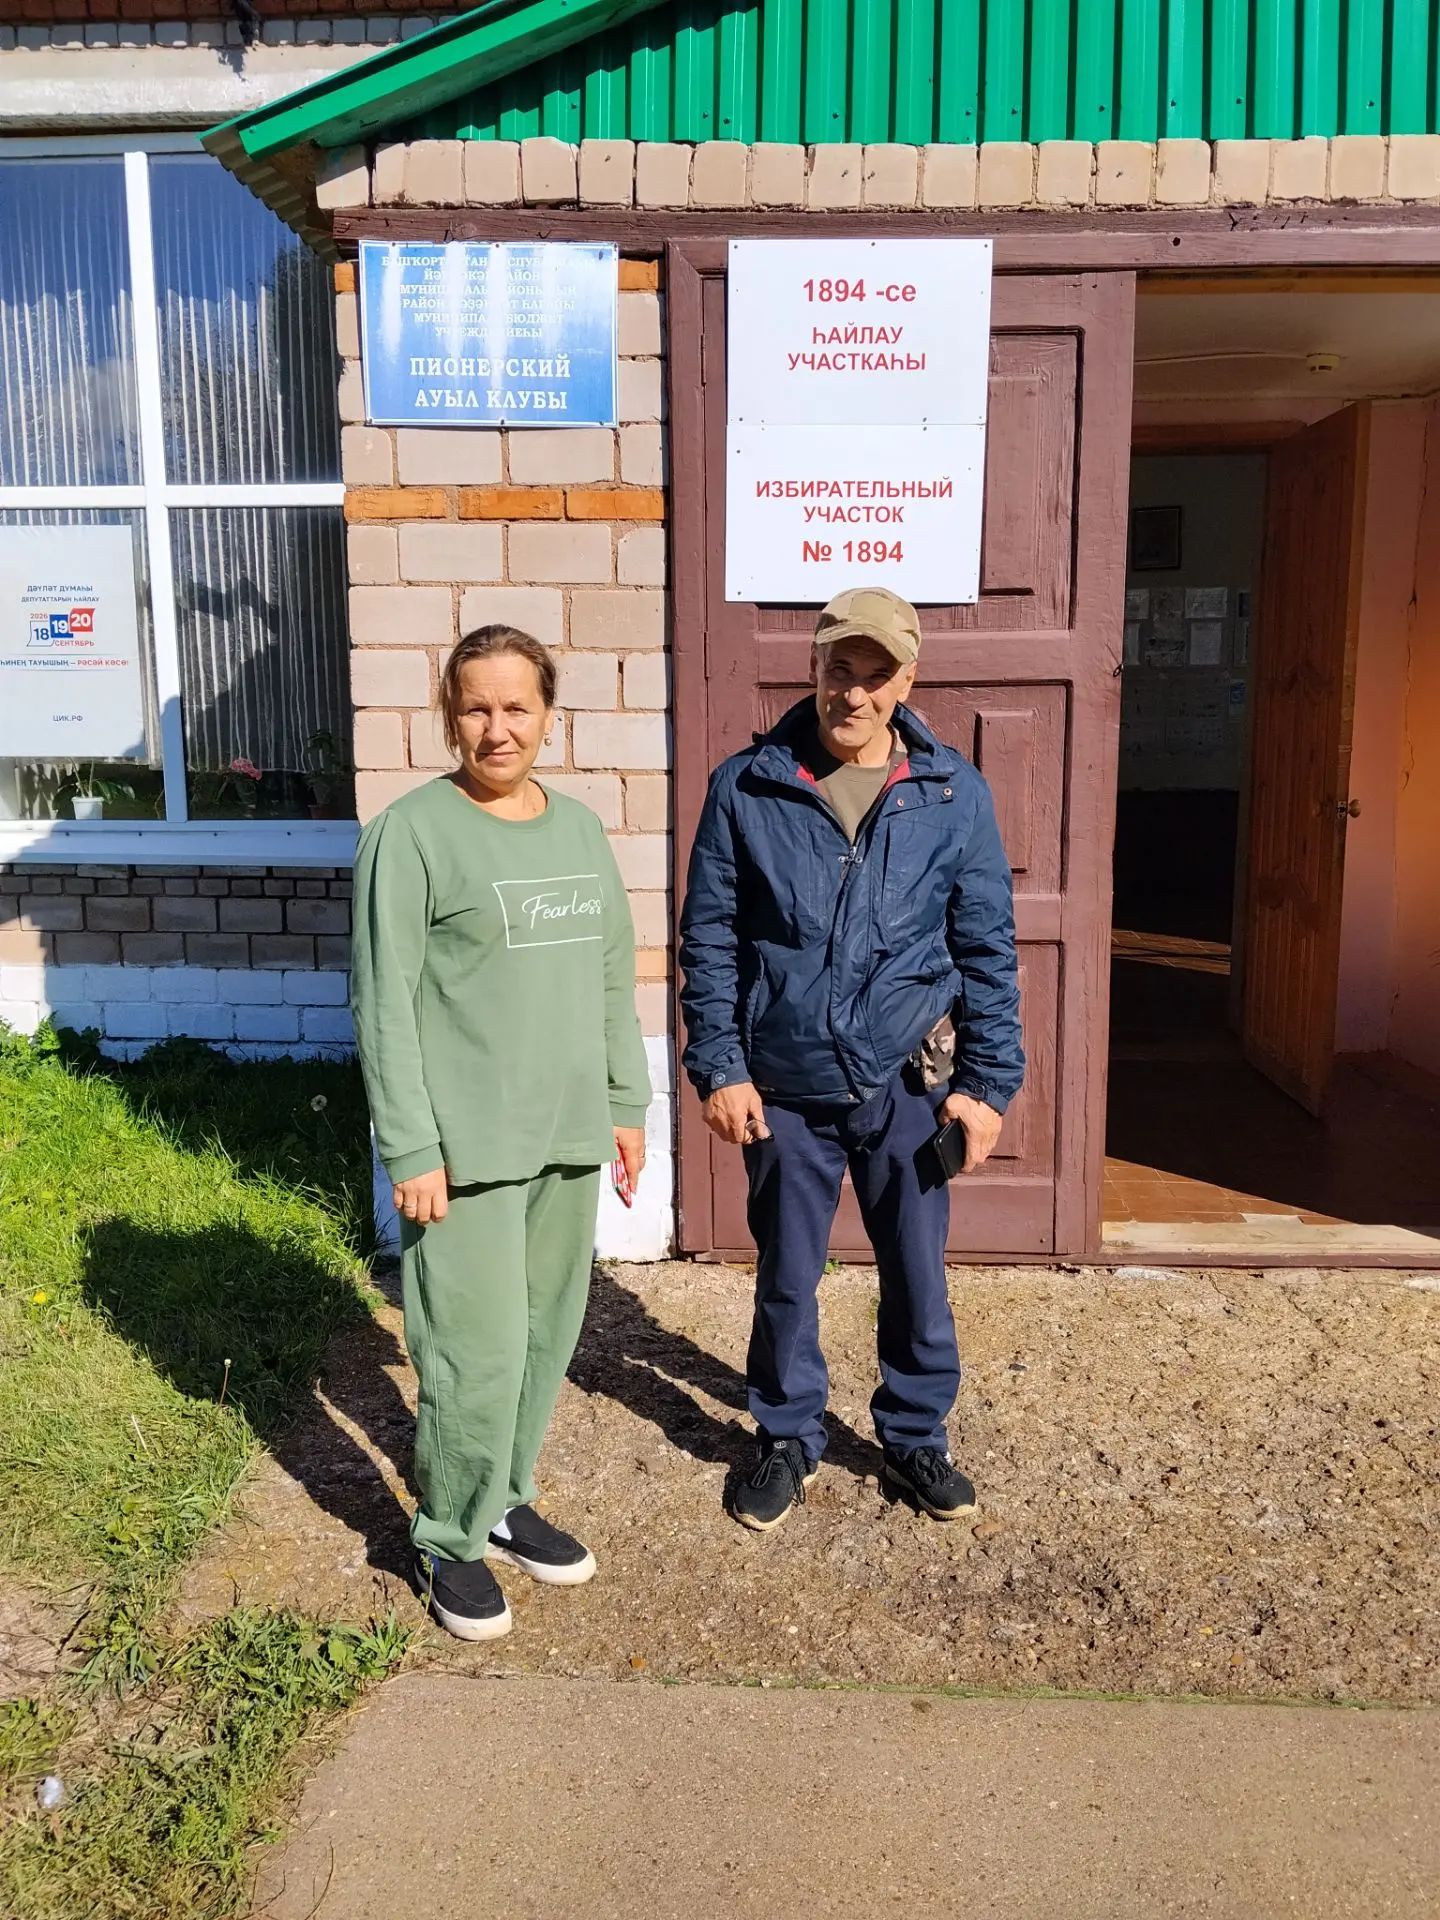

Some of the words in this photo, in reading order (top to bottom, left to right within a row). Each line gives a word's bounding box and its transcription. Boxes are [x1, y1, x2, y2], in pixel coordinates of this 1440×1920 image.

[803, 279, 866, 303] 1894
[876, 283, 917, 303] -се
[812, 322, 904, 345] ҺАЙЛАУ
[410, 354, 571, 378] ПИОНЕРСКИЙ
[787, 352, 927, 371] УЧАСТКАҺЫ
[415, 389, 479, 408] АУЫЛ
[486, 390, 568, 409] КЛУБЫ
[755, 476, 954, 499] ИЗБИРАТЕЛЬНЫЙ
[803, 505, 905, 524] УЧАСТОК
[802, 540, 832, 562] №
[842, 540, 904, 563] 1894
[33, 628, 50, 641] 18
[51, 619, 68, 634] 19
[71, 613, 92, 627] 20
[53, 715, 83, 723] ЦИК.РФ
[521, 889, 602, 930] Fearless
